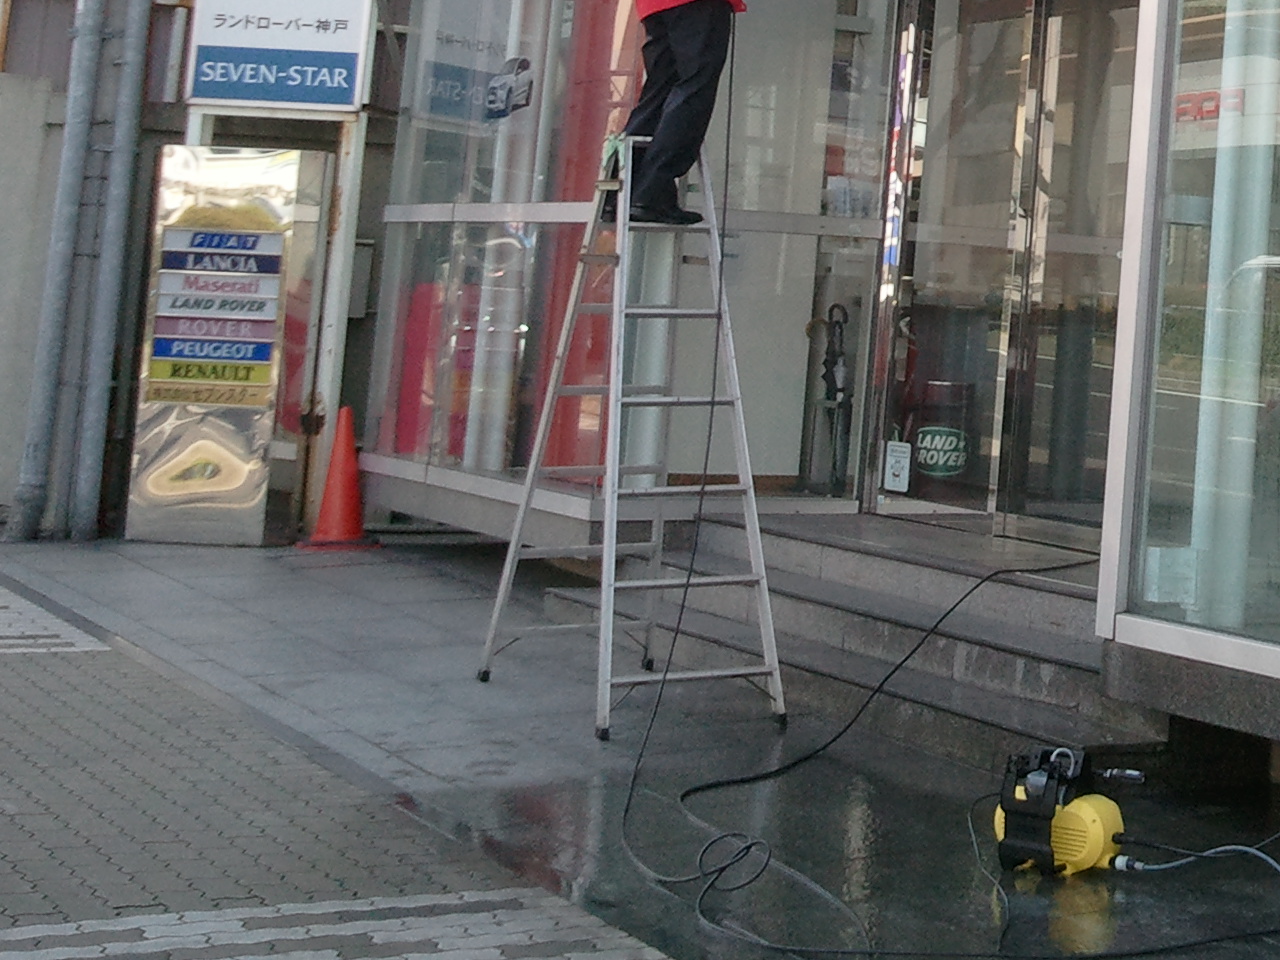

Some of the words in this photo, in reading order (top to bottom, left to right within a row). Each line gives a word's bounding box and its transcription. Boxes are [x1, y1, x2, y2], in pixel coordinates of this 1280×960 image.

[213, 13, 350, 35] ランドローバー神戸
[200, 60, 349, 89] SEVEN-STAR
[193, 234, 258, 248] FIAT
[185, 254, 259, 273] LANCIA
[182, 275, 260, 294] Maserati
[169, 297, 214, 311] LAND
[217, 299, 267, 313] ROVER
[177, 319, 251, 338] ROVER
[170, 340, 257, 358] PEUGEOT
[169, 362, 255, 381] RENAULT
[917, 433, 956, 452] LAND
[917, 449, 967, 467] ROVER
